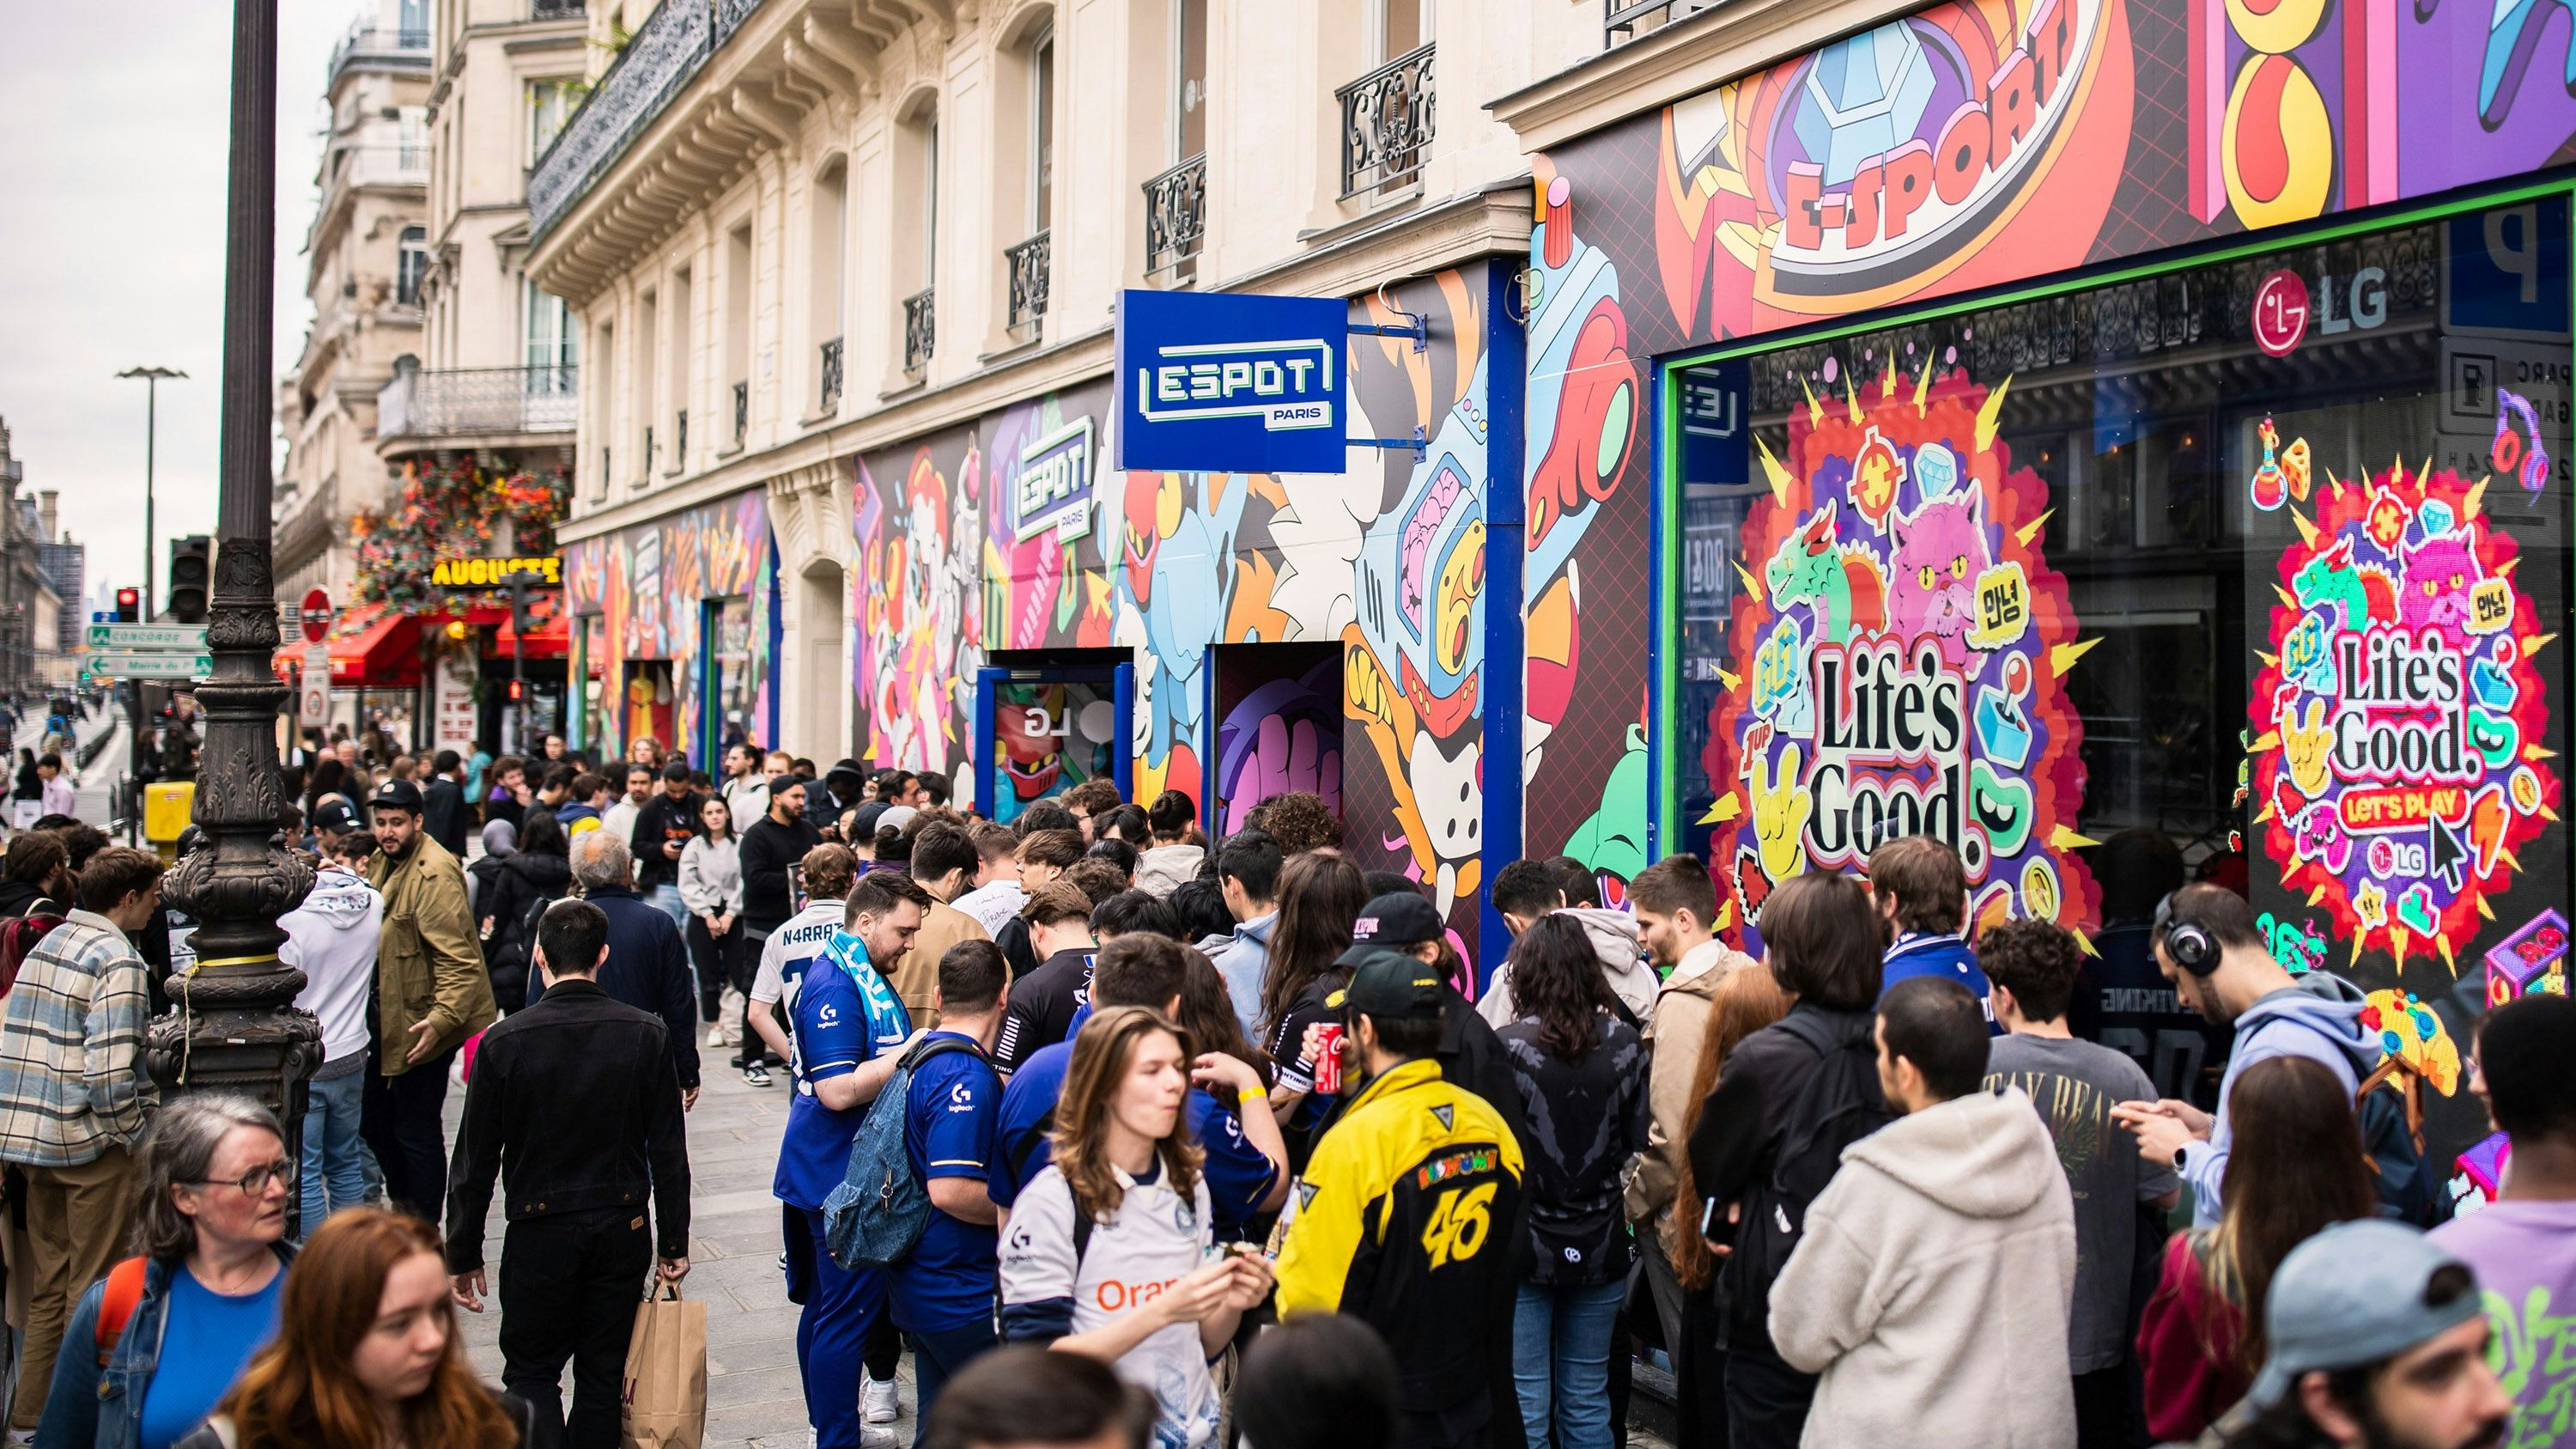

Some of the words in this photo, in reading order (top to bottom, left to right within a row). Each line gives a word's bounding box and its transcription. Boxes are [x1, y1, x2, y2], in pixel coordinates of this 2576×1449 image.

[2321, 266, 2388, 336] LG
[1273, 408, 1321, 421] PARIS
[1062, 509, 1084, 530] PARIS
[1984, 579, 2020, 630] 안녕
[112, 631, 180, 642] CONCORDE
[2343, 636, 2459, 702] Life's
[1821, 652, 1959, 752] Life's
[1743, 723, 1771, 772] 1UP
[2335, 709, 2476, 776] Good.
[1809, 763, 1980, 866] Good.
[2347, 795, 2403, 824] LET'S
[2405, 788, 2458, 818] PLAY
[2397, 849, 2422, 871] LG
[1421, 1182, 1499, 1272] 46
